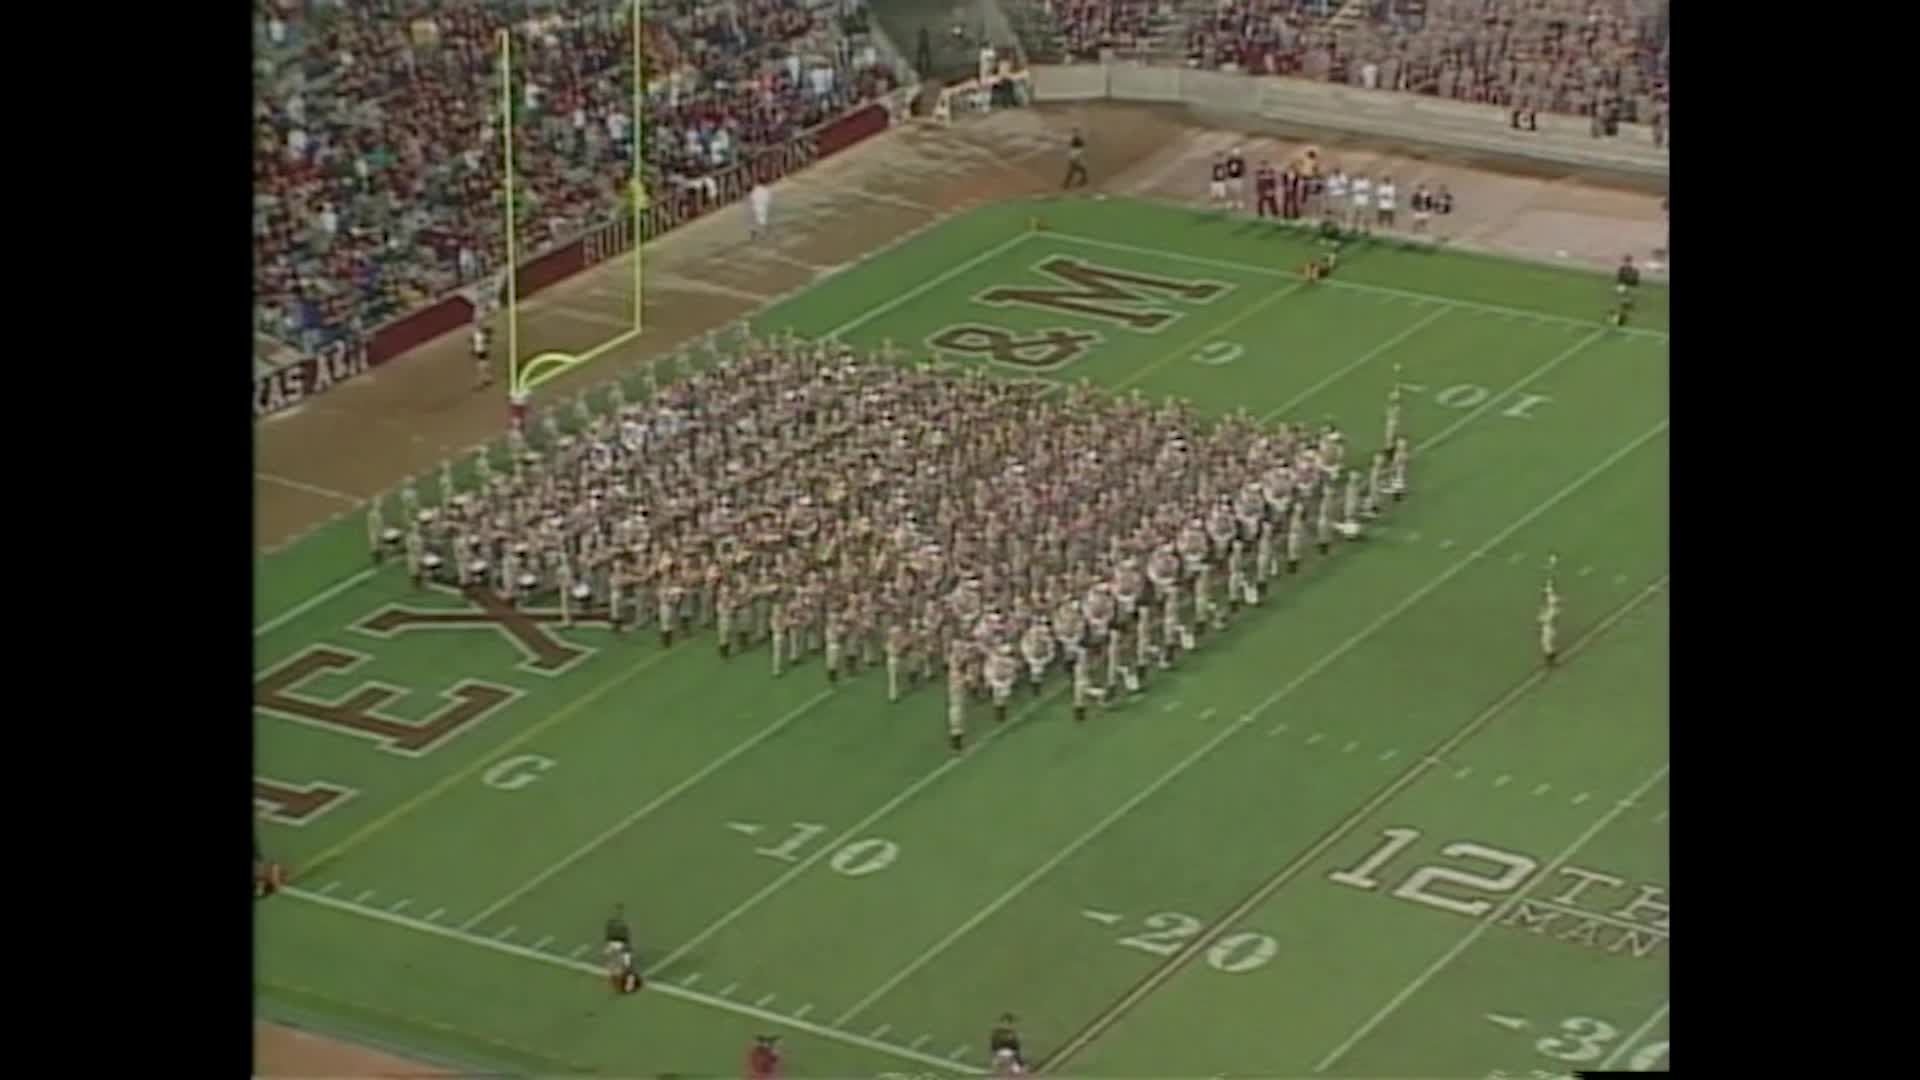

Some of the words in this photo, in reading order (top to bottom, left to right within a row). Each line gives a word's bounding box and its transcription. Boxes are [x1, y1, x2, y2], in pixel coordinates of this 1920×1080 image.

[483, 754, 558, 790] G
[754, 821, 899, 876] 10
[1116, 911, 1279, 972] 20
[1501, 903, 1669, 957] MAN
